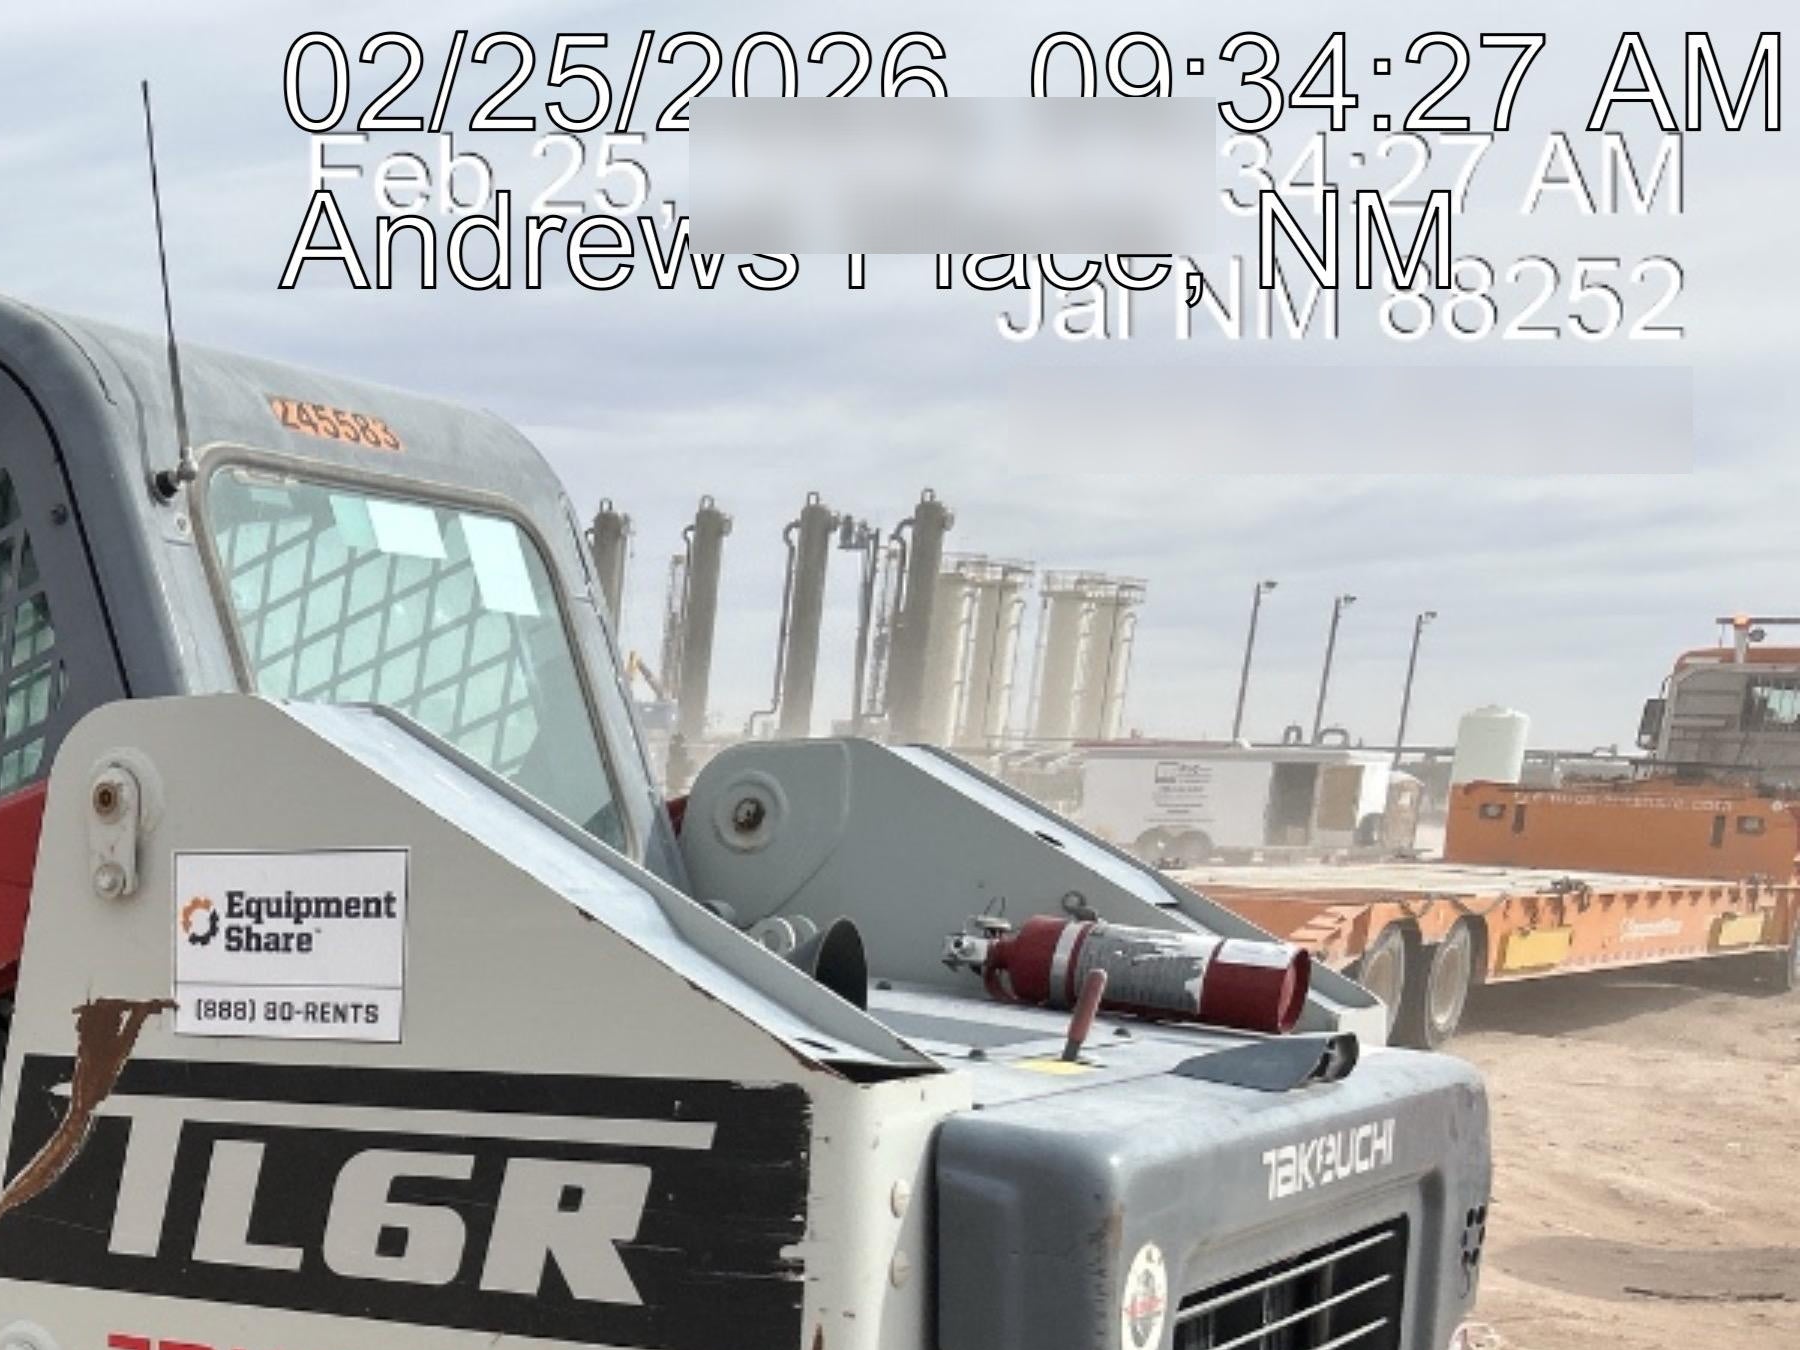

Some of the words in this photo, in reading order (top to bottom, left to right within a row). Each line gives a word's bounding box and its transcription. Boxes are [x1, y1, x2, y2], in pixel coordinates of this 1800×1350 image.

[225, 890, 397, 925] Equipment
[225, 924, 315, 953] Share
[195, 998, 257, 1022] (888)
[263, 1000, 380, 1025] 80-RENTS
[1262, 1117, 1397, 1201] TAKEUCHI
[52, 1082, 717, 1307] TL6R
